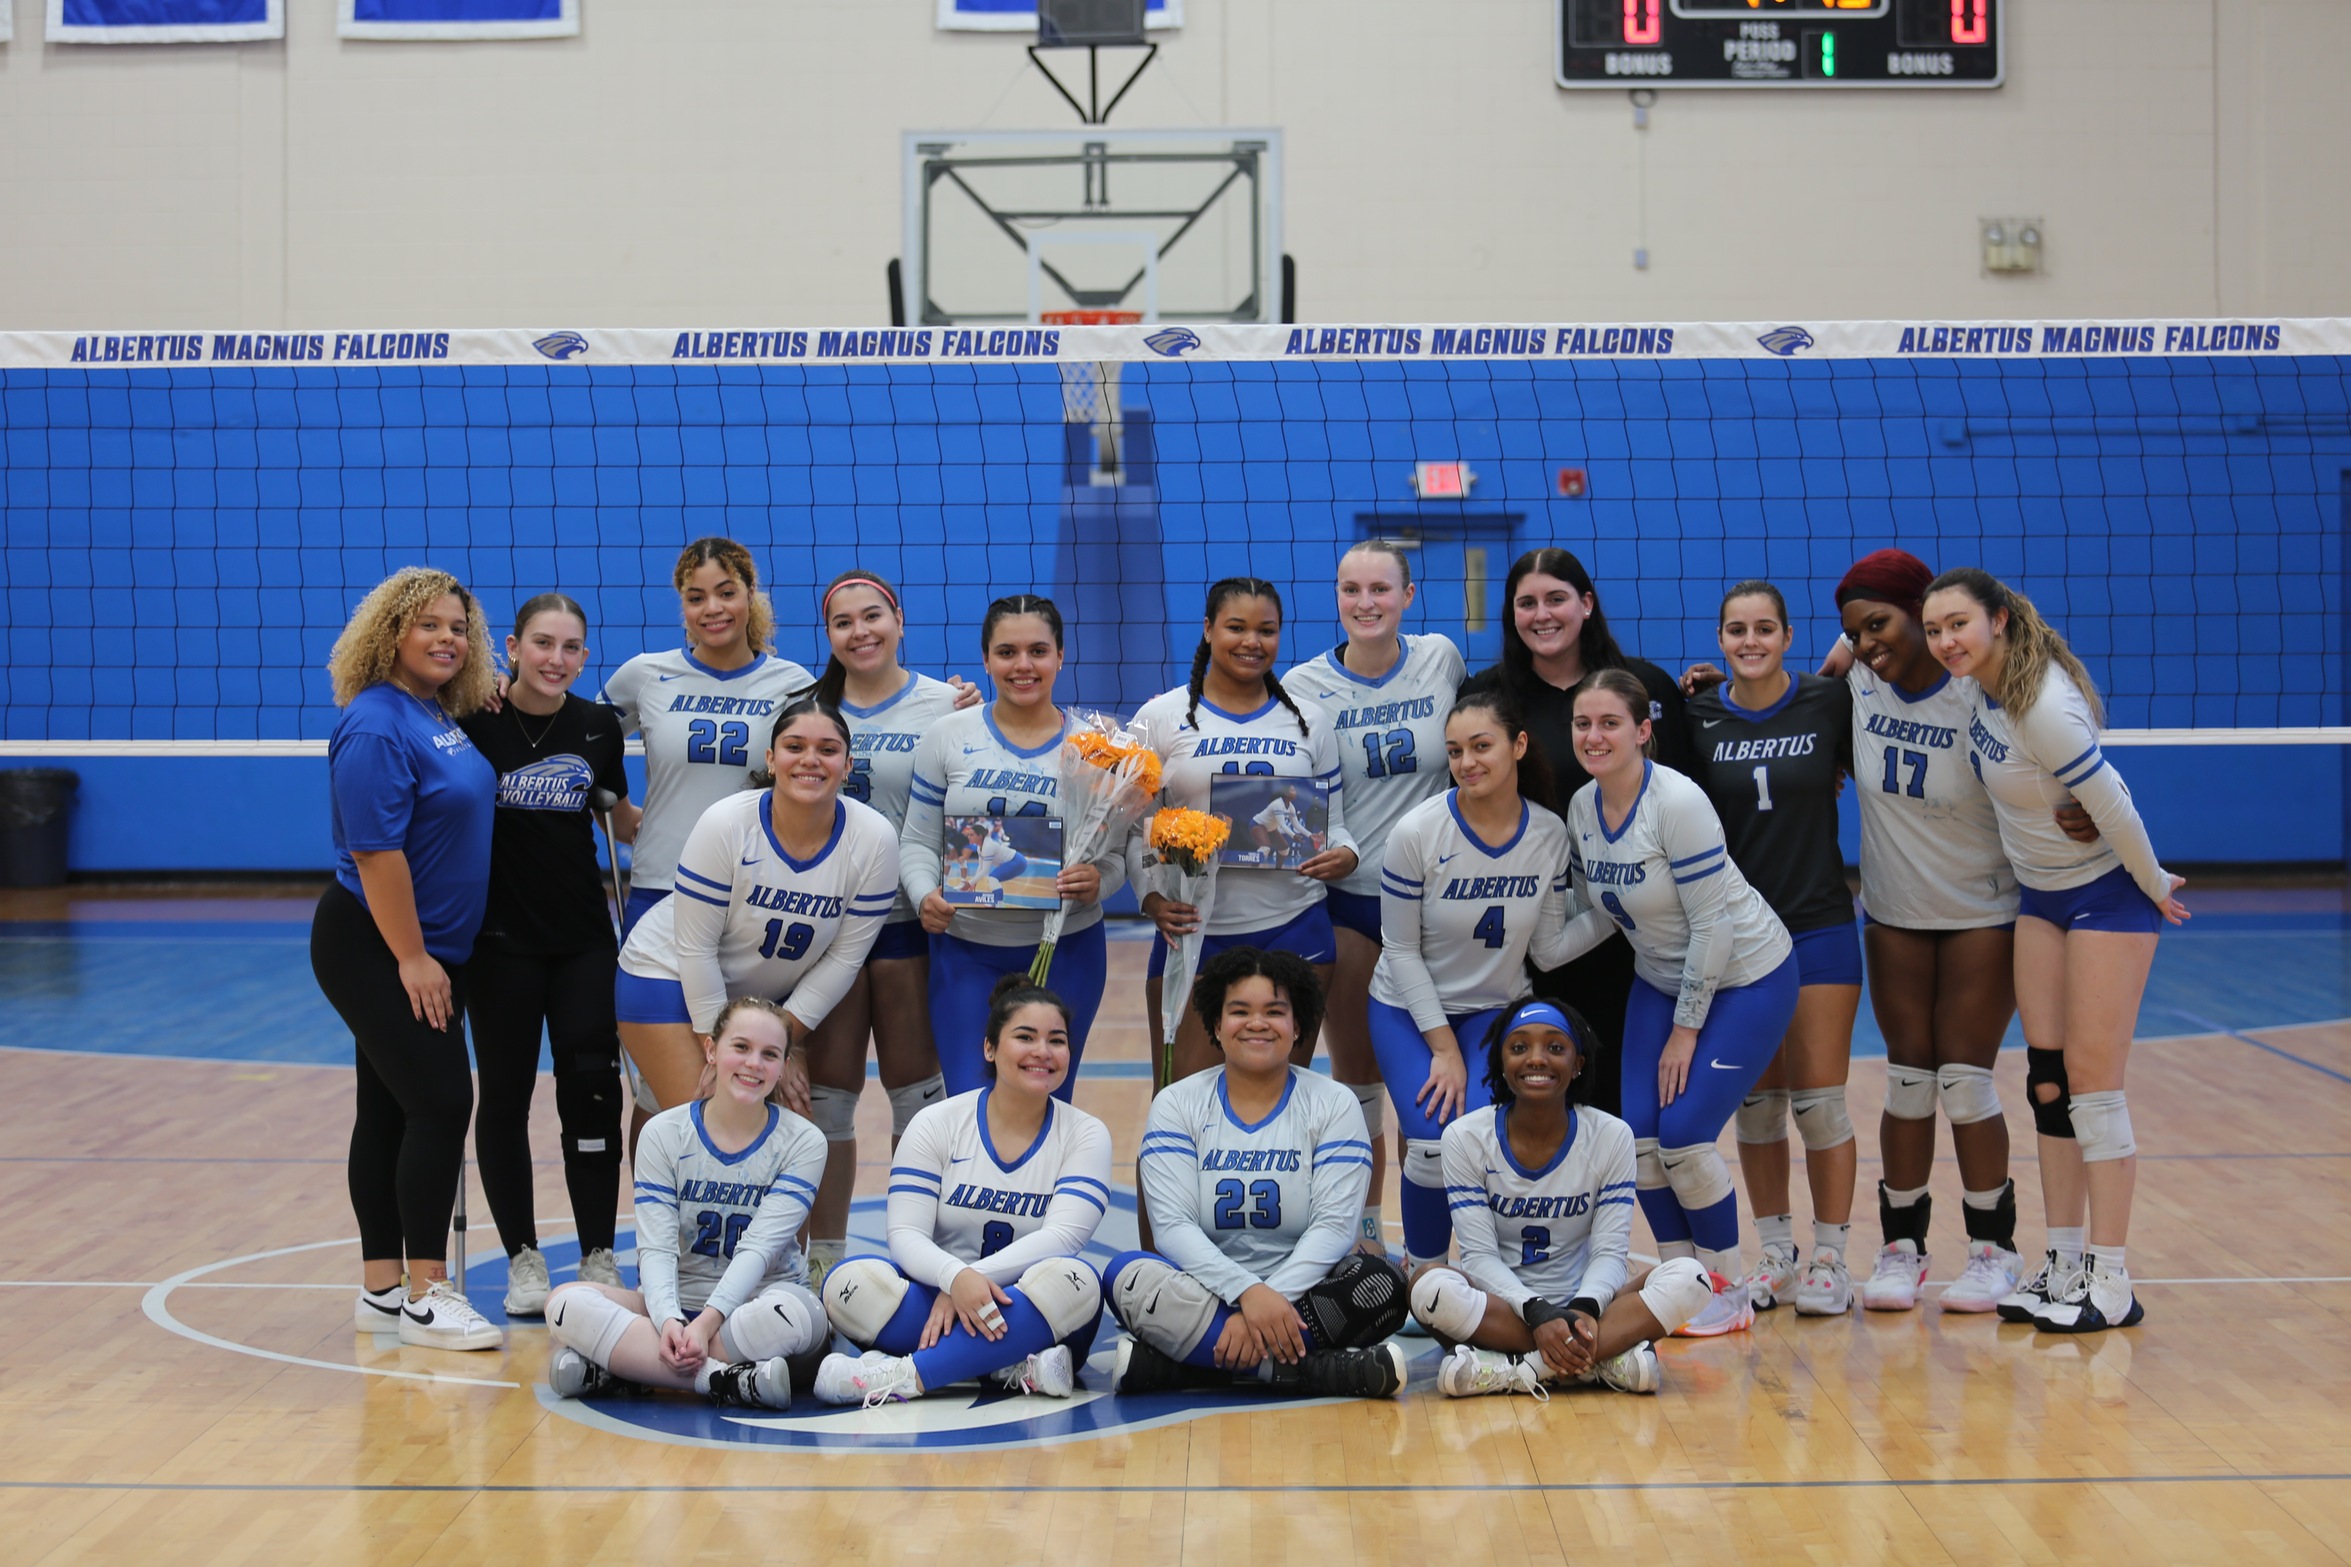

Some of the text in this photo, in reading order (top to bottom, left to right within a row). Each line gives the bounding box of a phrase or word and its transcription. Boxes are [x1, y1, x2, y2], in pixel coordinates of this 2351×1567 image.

[1740, 22, 1780, 40] POSS
[1605, 53, 1673, 75] BONUS
[1724, 39, 1797, 61] PERIOD
[1822, 31, 1834, 77] 1
[1888, 53, 1954, 75] BONUS
[71, 333, 450, 362] ALBERTUS MAGNUS FALCONS
[672, 330, 1060, 358] ALBERTUS MAGNUS FALCONS
[1285, 328, 1674, 354] ALBERTUS MAGNUS FALCONS
[1897, 325, 2281, 353] ALBERTUS MAGNUS FALCONS
[668, 694, 774, 717] ALBERTUS
[1334, 695, 1434, 730] ALBERTUS
[687, 718, 749, 767] 22
[849, 733, 920, 752] ERTUS
[1864, 713, 1957, 749] ALBERTUS
[1193, 737, 1297, 758] ALBERTUS
[1362, 728, 1417, 779] 12
[1713, 733, 1817, 762] ALBERTUS
[500, 774, 569, 792] ALBERTUS
[843, 758, 871, 804] 5
[1882, 745, 1928, 799] 17
[501, 790, 584, 808] VOLLEYBALL
[1753, 765, 1773, 811] 1
[746, 884, 843, 919] ALBERTUS
[1441, 875, 1540, 900] ALBERTUS
[1601, 891, 1636, 930] 9
[758, 918, 815, 960] 19
[1473, 905, 1505, 949] 4
[1202, 1148, 1301, 1172] ALBERTUS
[680, 1179, 771, 1208] ALBERTU
[945, 1184, 1053, 1218] ALBERTU
[1214, 1178, 1281, 1230] 23
[1489, 1192, 1590, 1218] ALBERTUS
[1521, 1225, 1551, 1266] 2
